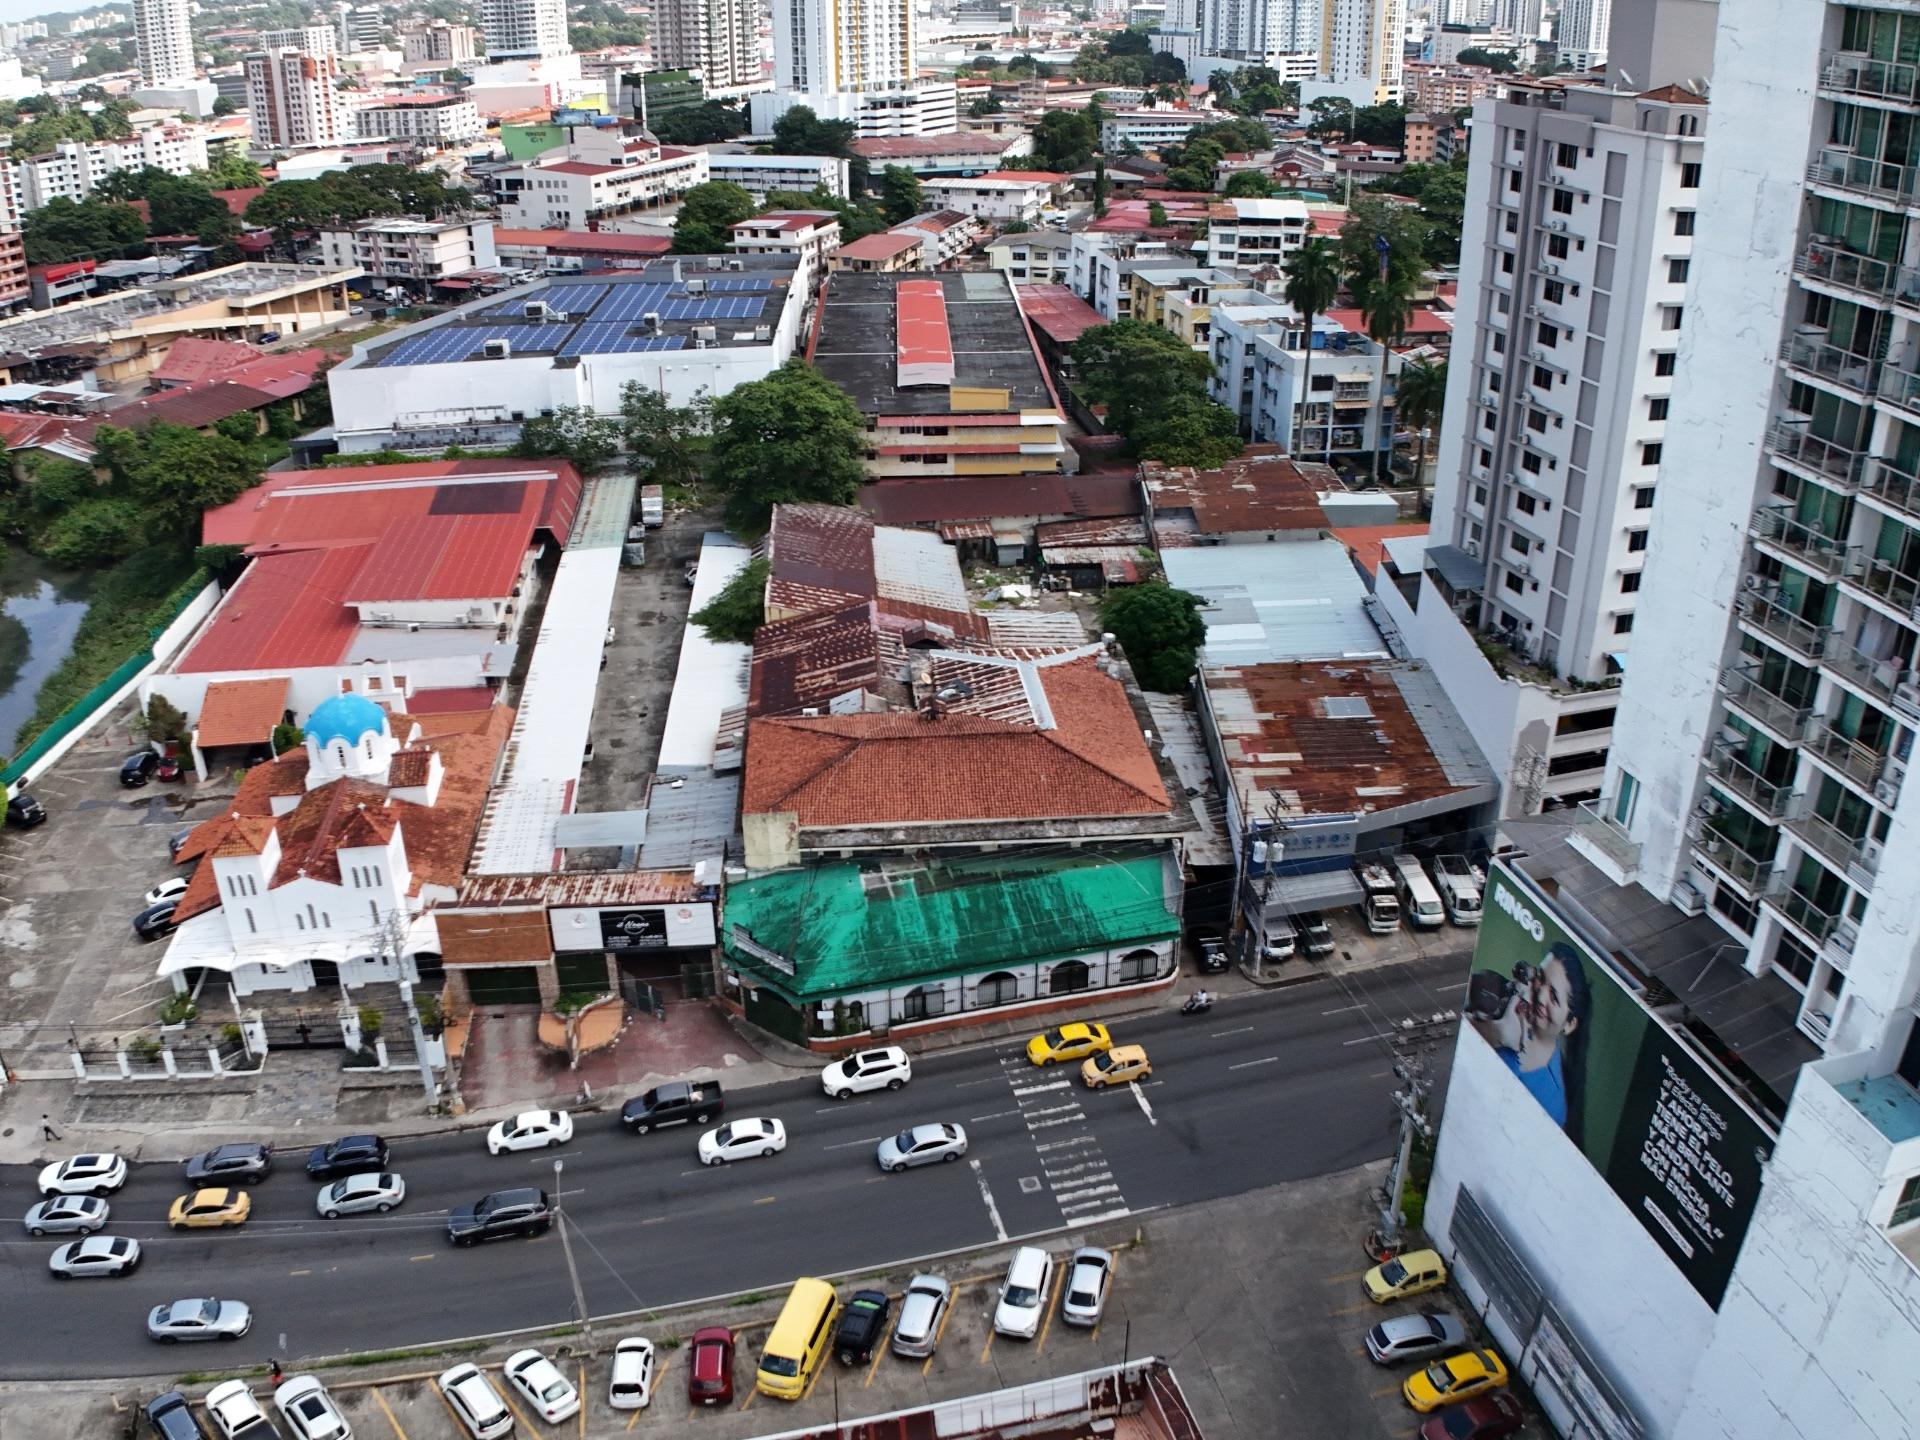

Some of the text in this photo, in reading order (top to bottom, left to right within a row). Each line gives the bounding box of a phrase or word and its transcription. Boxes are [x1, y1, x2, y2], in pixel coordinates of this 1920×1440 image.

[1494, 882, 1545, 942] RINGO
[1656, 1100, 1733, 1187] TIENE EL PELO
[1660, 1086, 1709, 1146] Y AHORA
[1698, 1112, 1723, 1142] Ringo
[1640, 1151, 1667, 1183] MÁS
[1644, 1139, 1670, 1172] CON
[1669, 1165, 1710, 1218] MUCHA
[1649, 1125, 1658, 1140] Y
[1656, 1138, 1690, 1178] ANDA
[1651, 1113, 1678, 1146] MÁS
[1677, 1143, 1736, 1209] BRILLANTE
